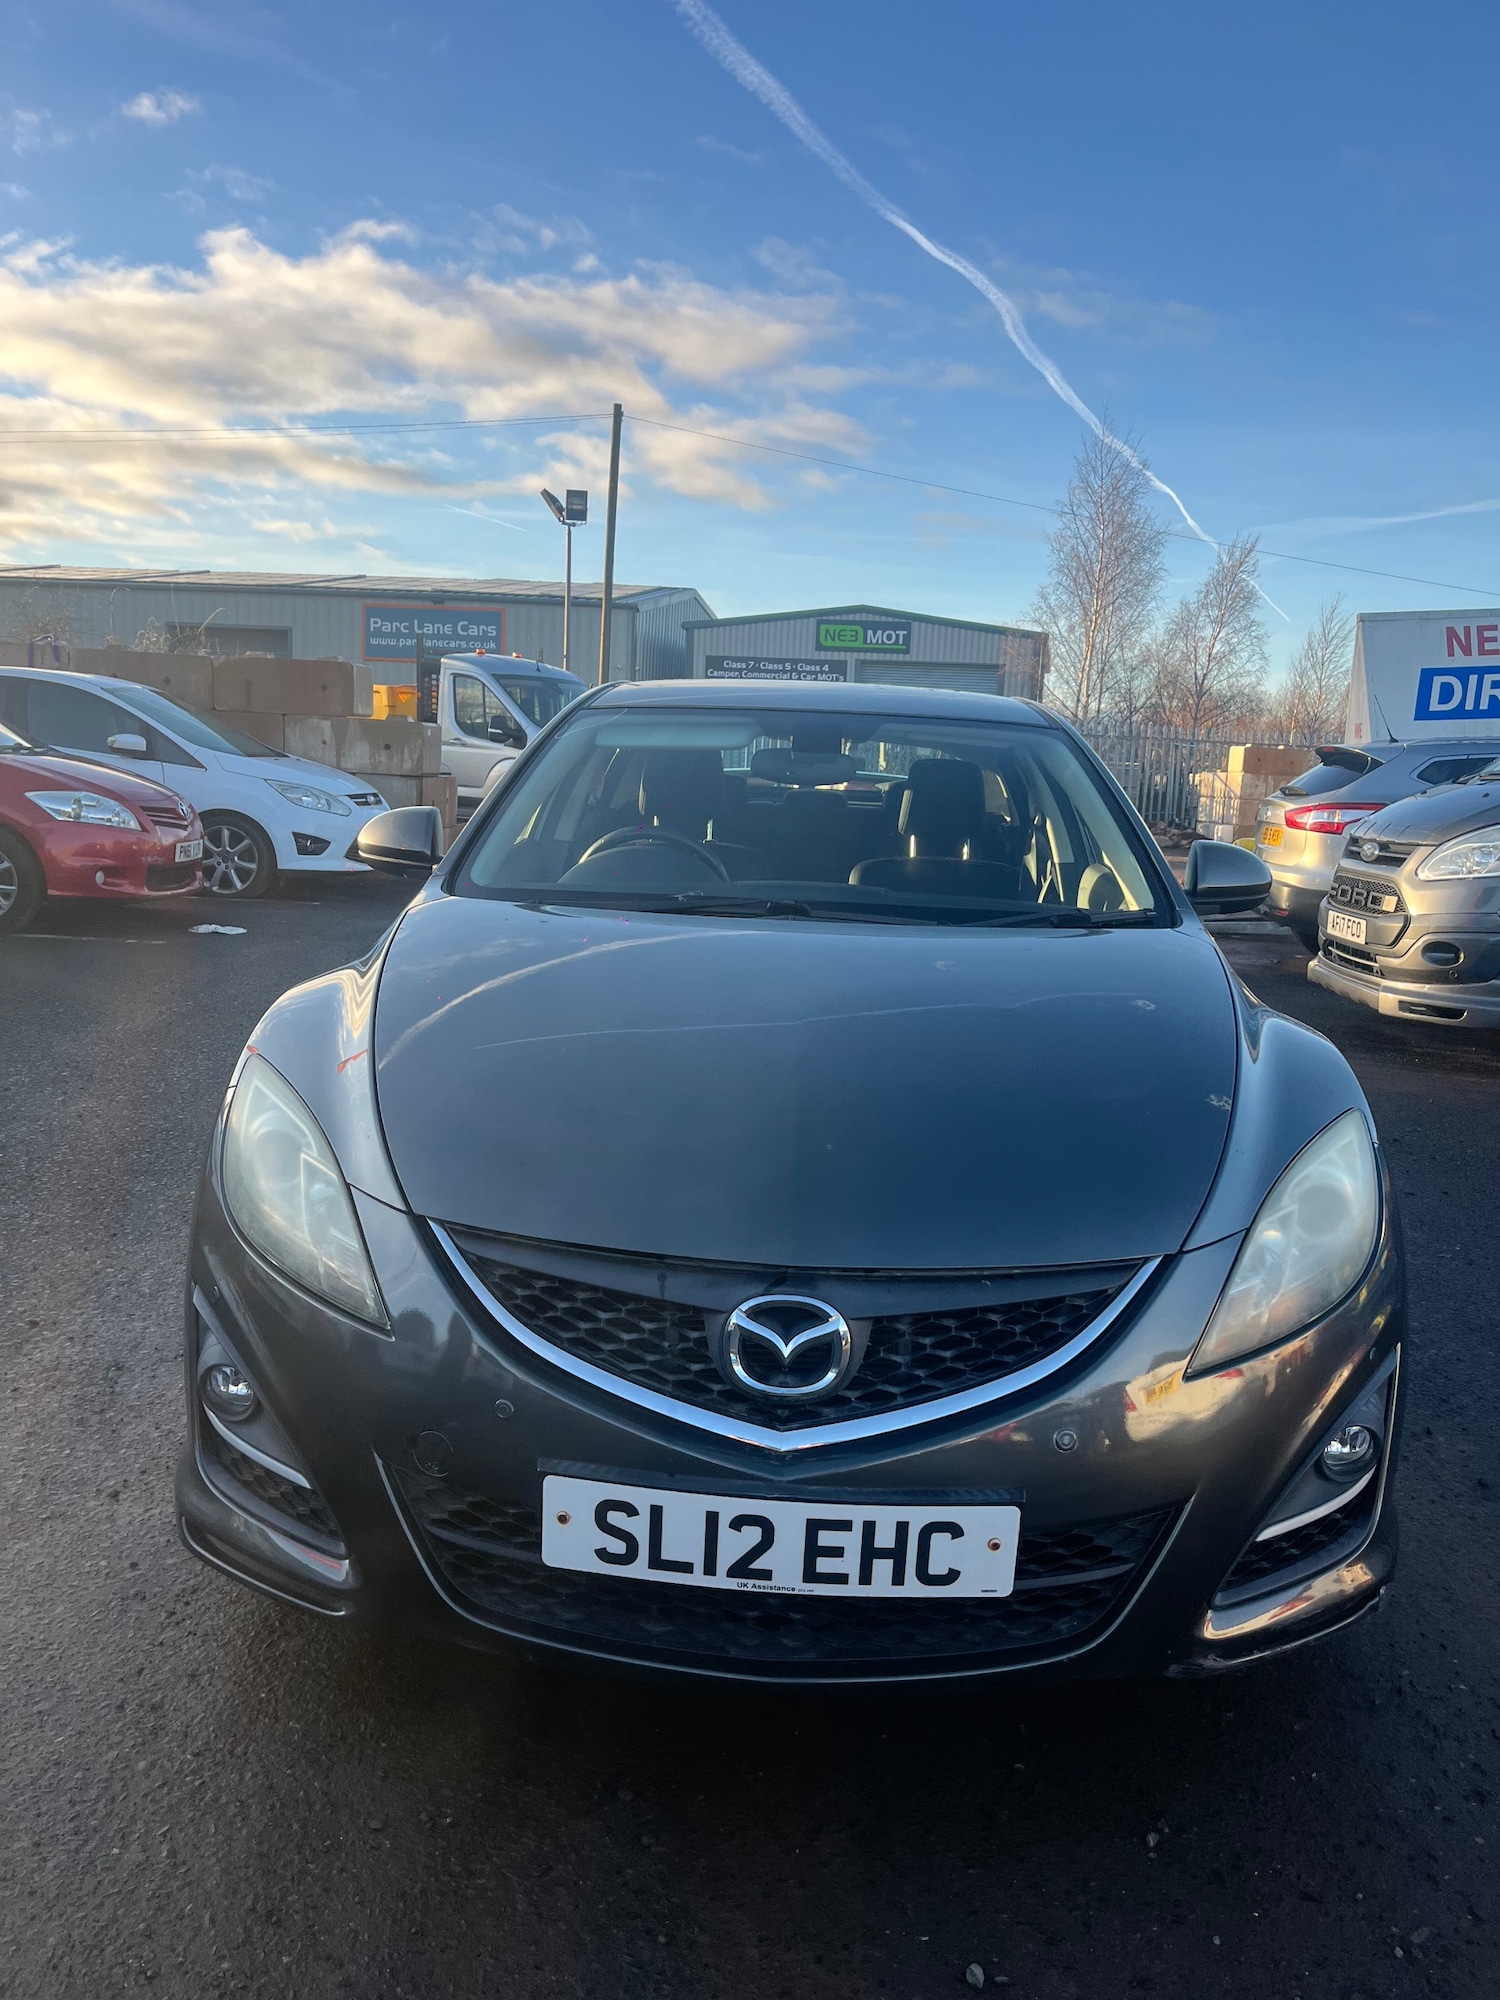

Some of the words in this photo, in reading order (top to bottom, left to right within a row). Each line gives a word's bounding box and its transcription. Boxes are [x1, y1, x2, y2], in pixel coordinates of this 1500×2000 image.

[370, 617, 409, 633] Parc
[414, 619, 453, 635] Lane
[457, 621, 497, 636] Cars
[370, 636, 496, 650] www.parlanecars.co.uk
[866, 629, 907, 645] MOT
[723, 660, 747, 669] Class
[747, 661, 755, 669] 7
[760, 661, 783, 671] Class
[784, 662, 792, 671] 5
[797, 663, 821, 672] Class
[822, 664, 830, 672] 4
[707, 668, 740, 679] Camper,
[741, 670, 790, 680] Commercial
[791, 672, 800, 680] &
[800, 673, 817, 681] Car
[817, 673, 845, 682] MOT's
[593, 1498, 776, 1581] SL12
[801, 1517, 966, 1587] EHC
[750, 1583, 796, 1592] Assistance
